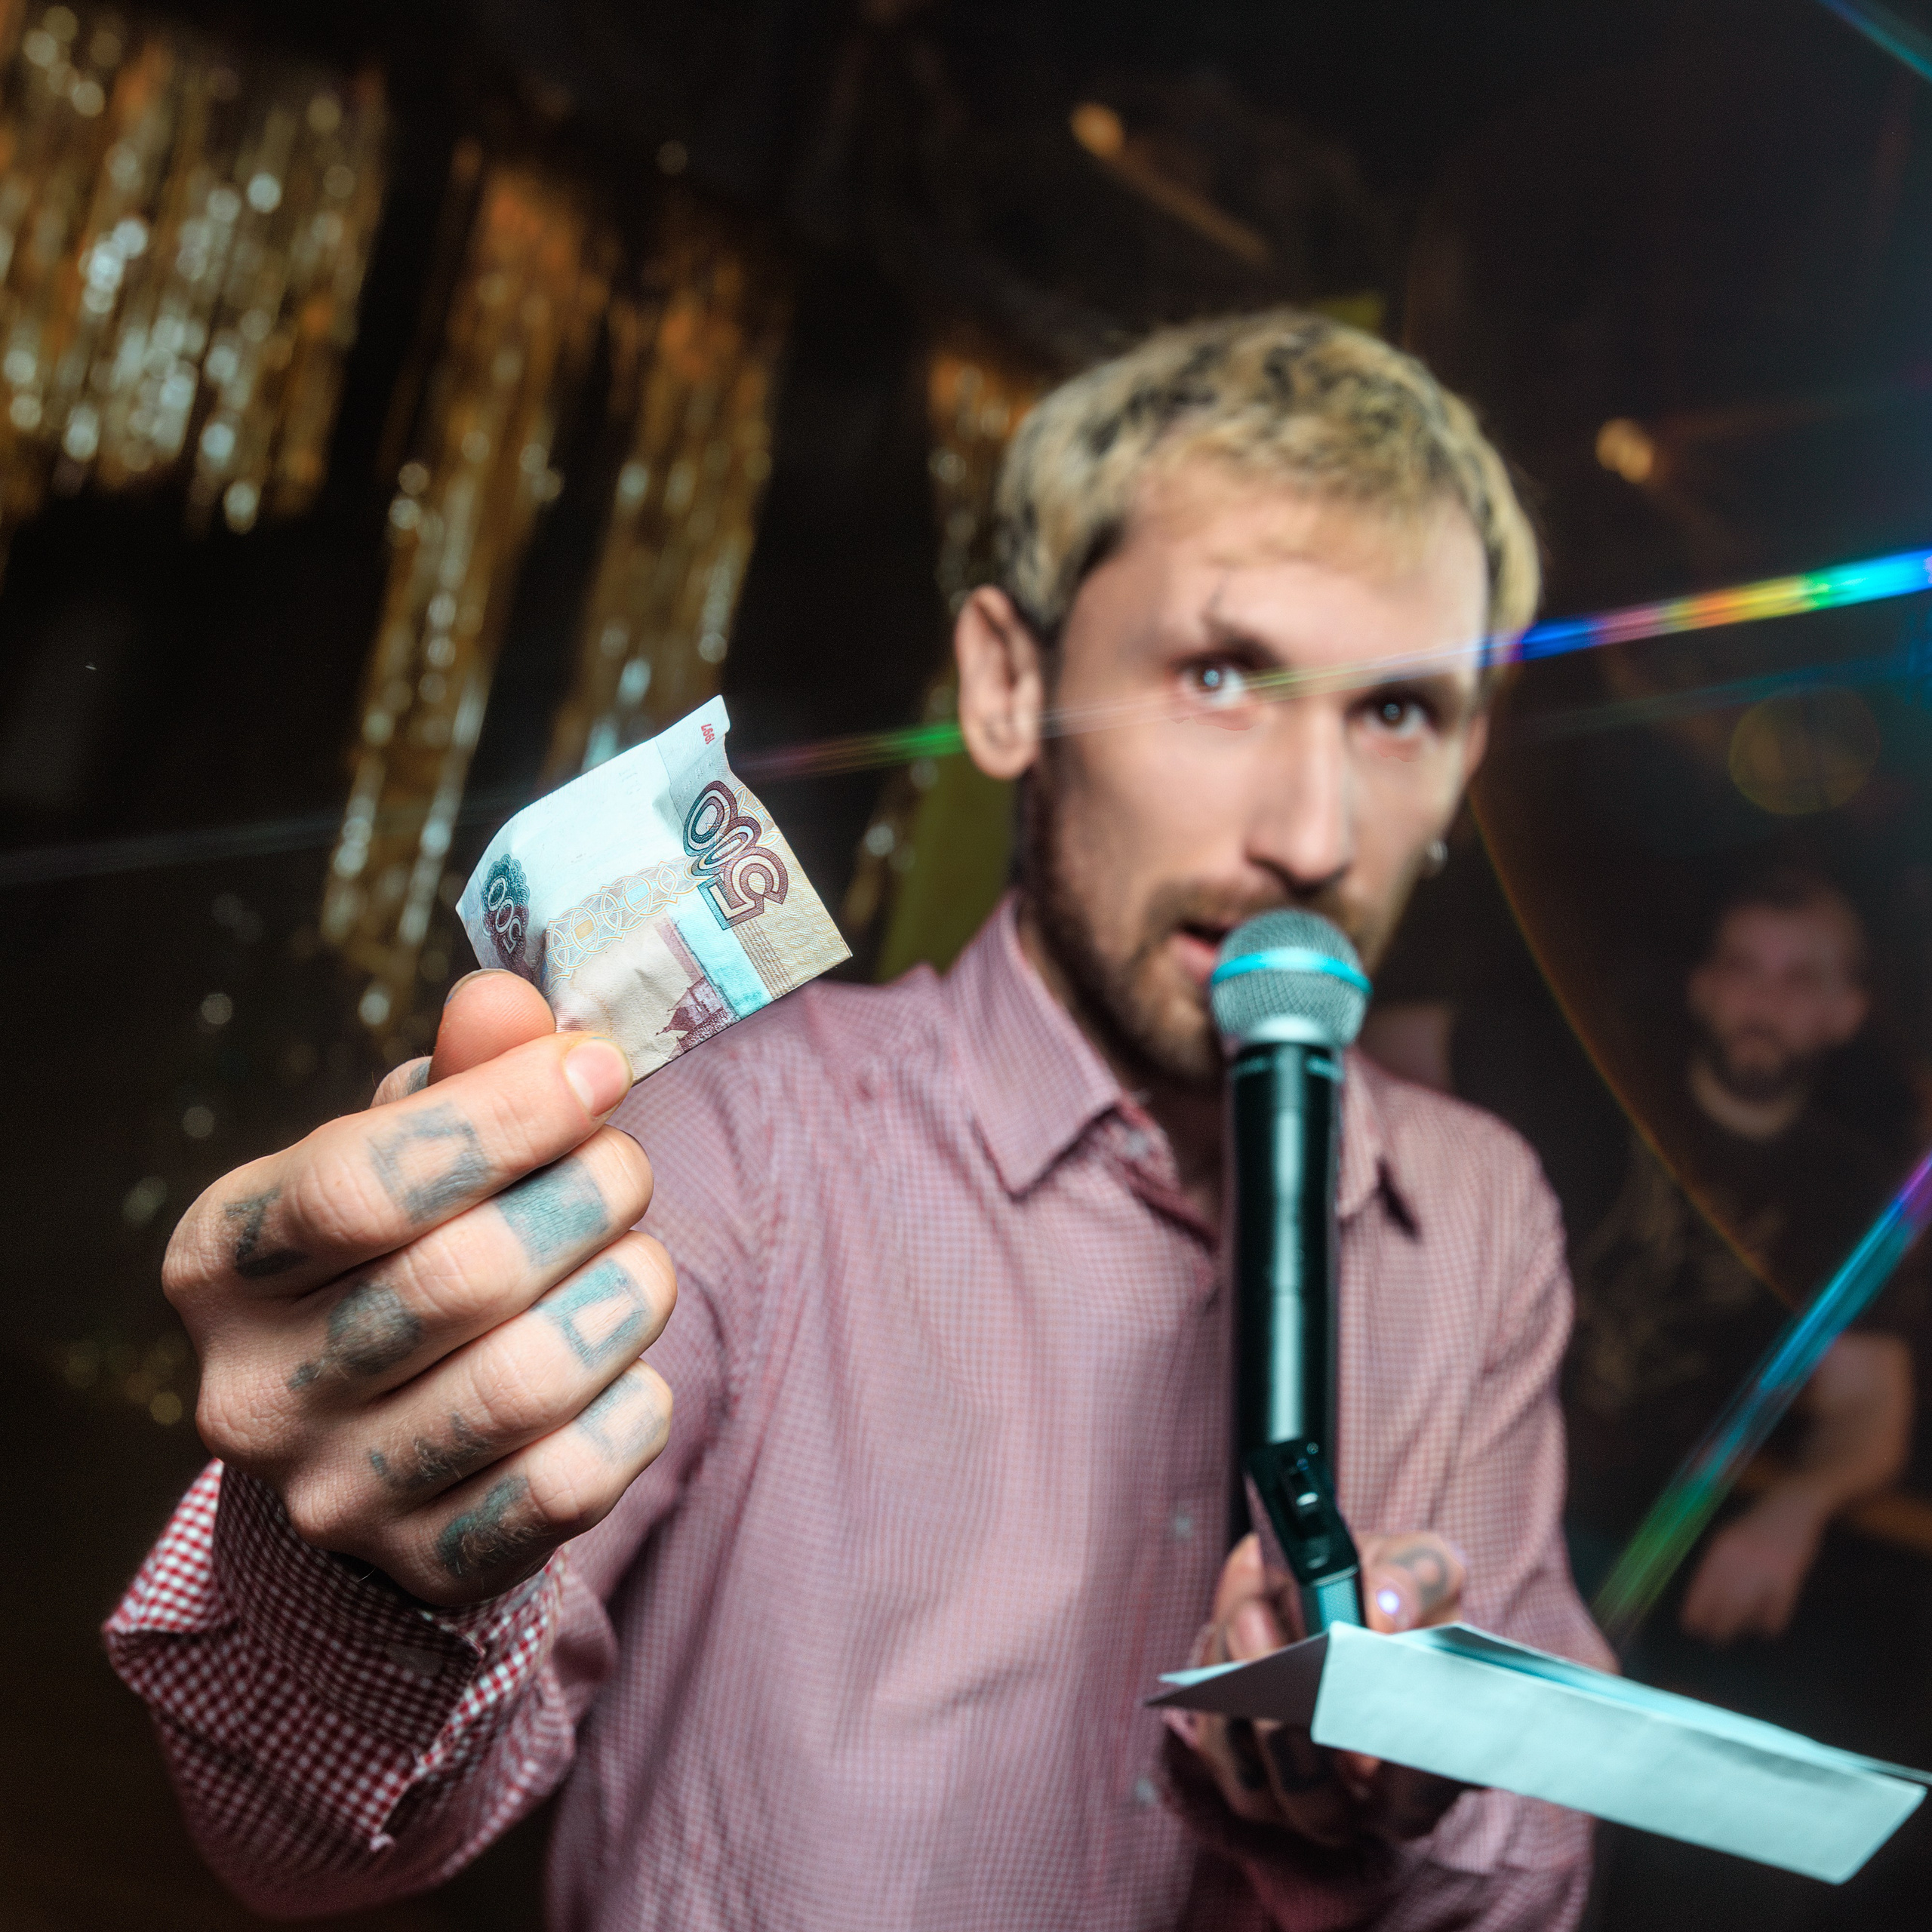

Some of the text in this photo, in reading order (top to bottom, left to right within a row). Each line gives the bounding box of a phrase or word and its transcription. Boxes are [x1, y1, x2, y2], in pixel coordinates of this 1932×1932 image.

[701, 724, 715, 744] 1997
[683, 780, 788, 931] 500
[488, 875, 521, 955] 500
